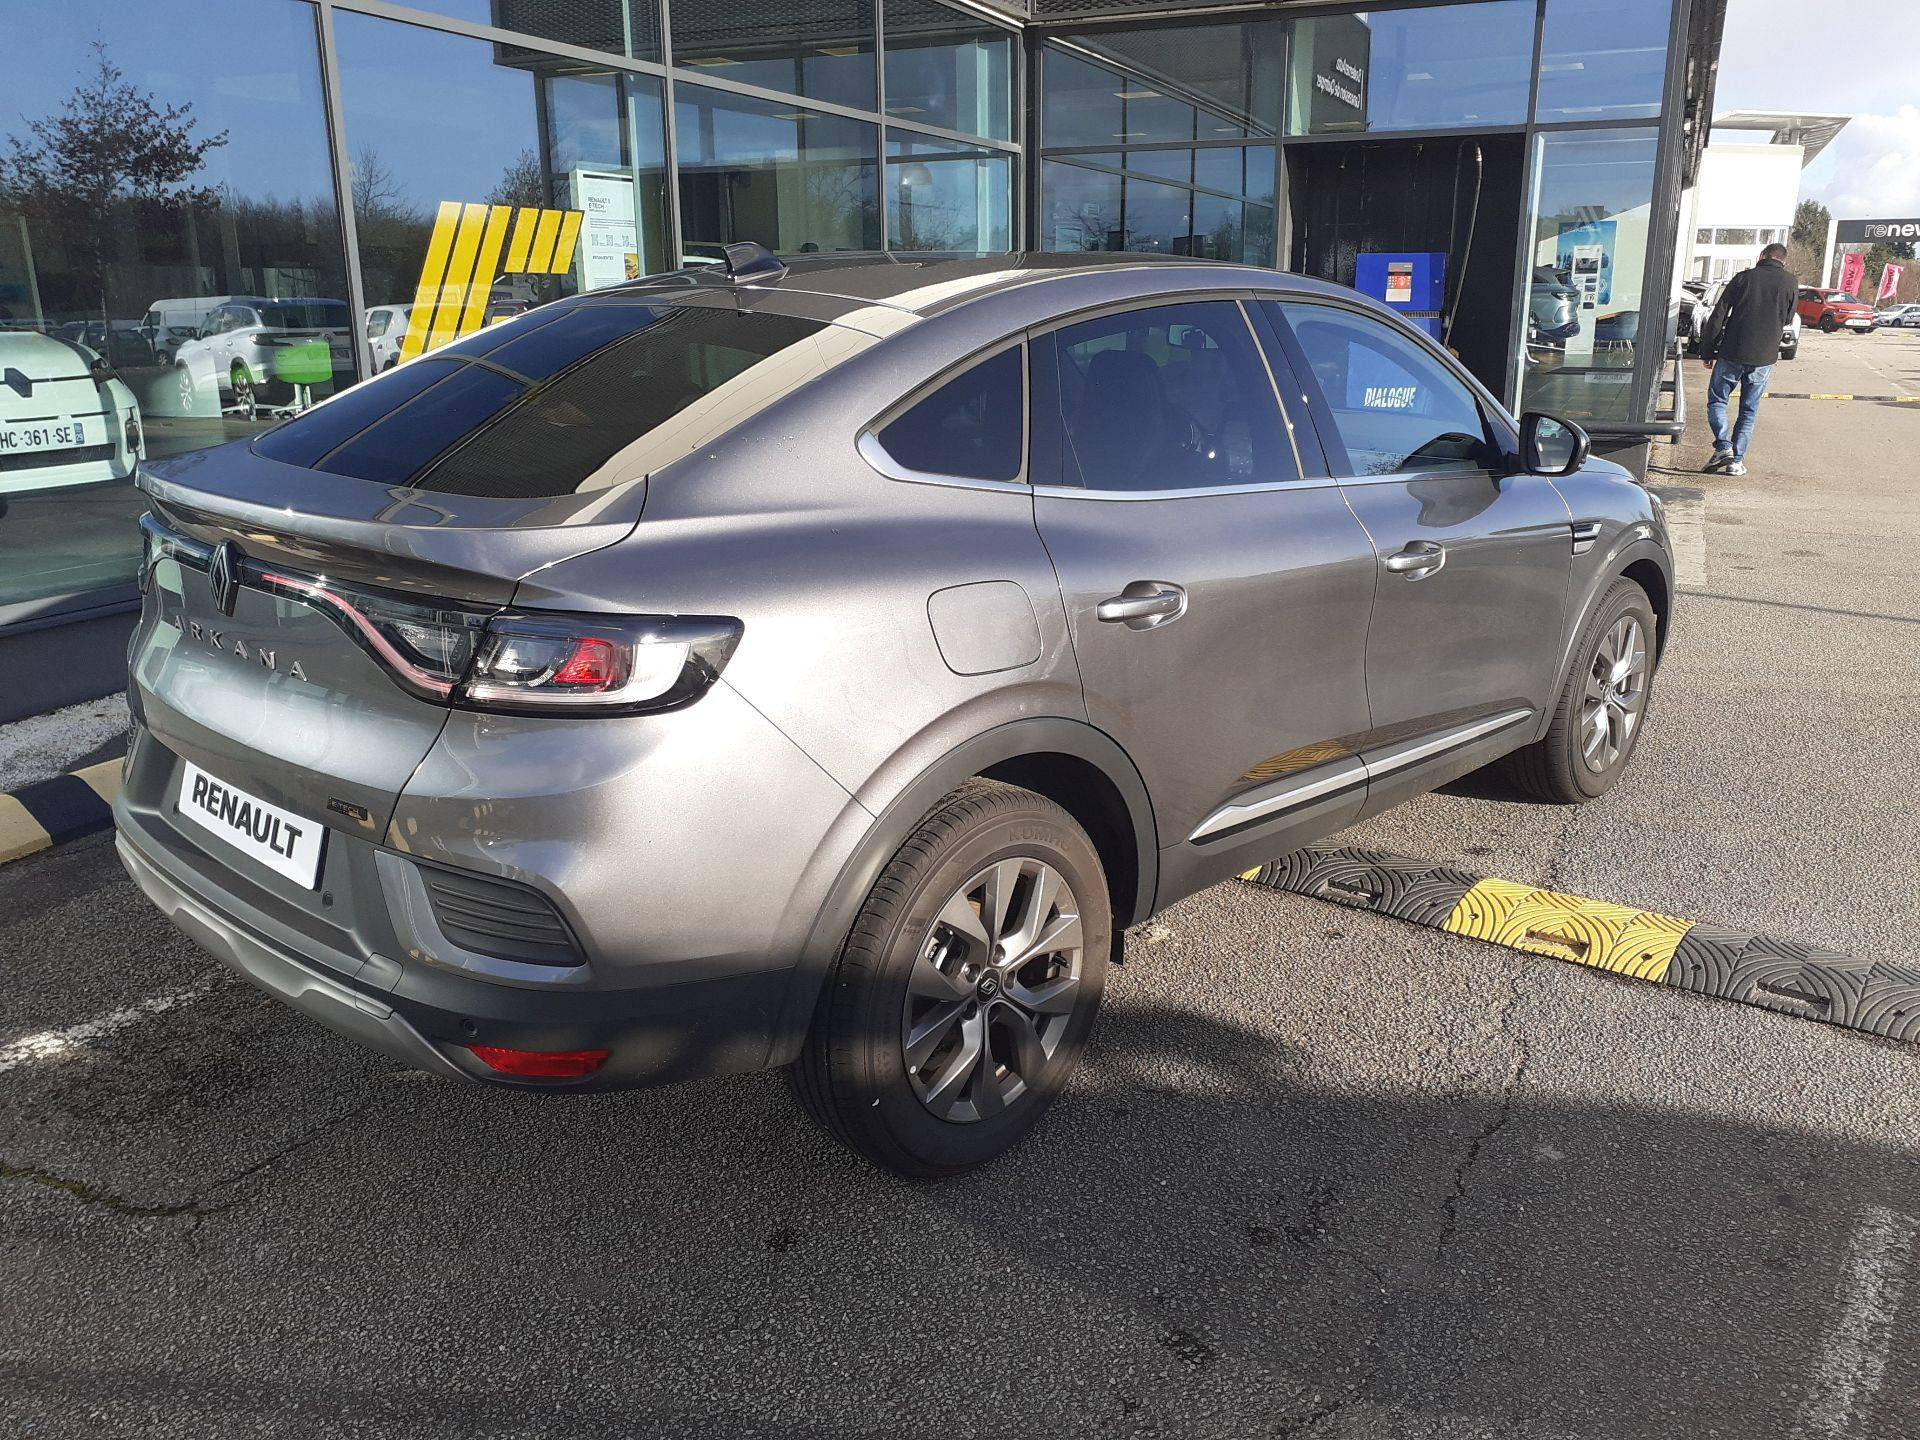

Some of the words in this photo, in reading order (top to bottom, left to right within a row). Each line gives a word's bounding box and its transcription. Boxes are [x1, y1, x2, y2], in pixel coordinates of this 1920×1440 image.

[1363, 387, 1417, 409] DIALOGUE
[174, 615, 308, 682] ARKANA
[191, 773, 303, 860] RENAULT
